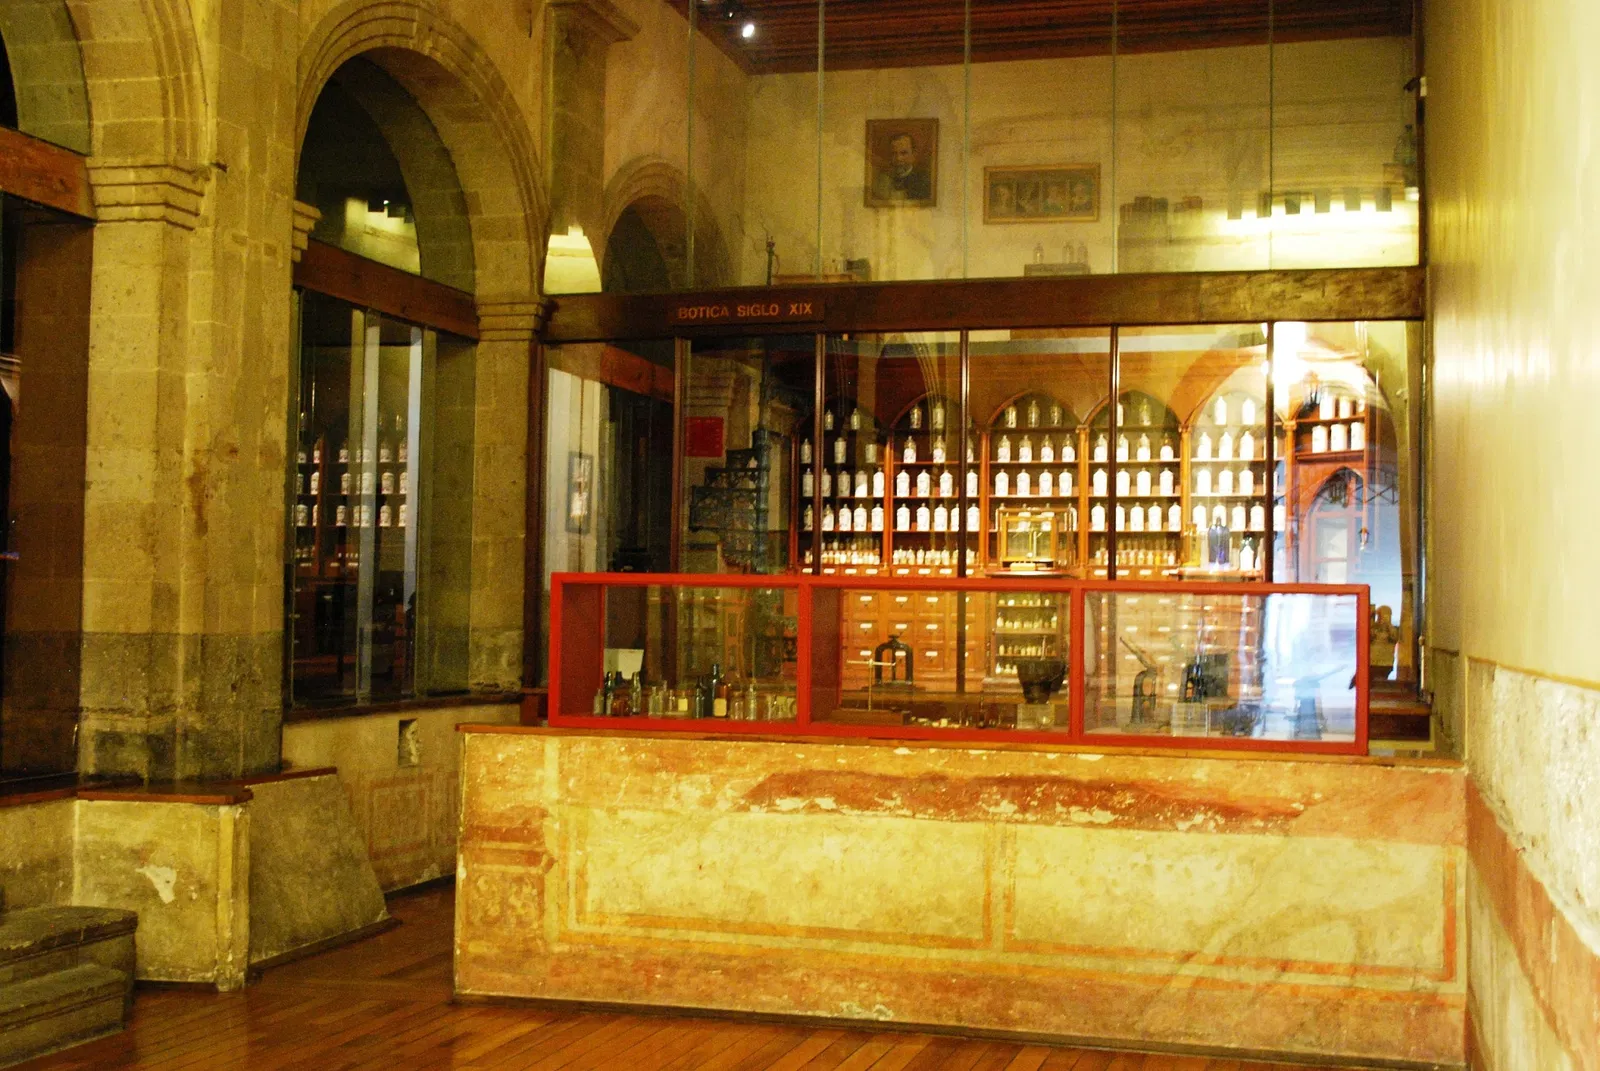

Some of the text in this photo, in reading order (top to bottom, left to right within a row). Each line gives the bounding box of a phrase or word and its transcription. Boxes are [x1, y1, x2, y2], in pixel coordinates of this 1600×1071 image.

[678, 302, 813, 319] BOTICA SIGLO XIX
